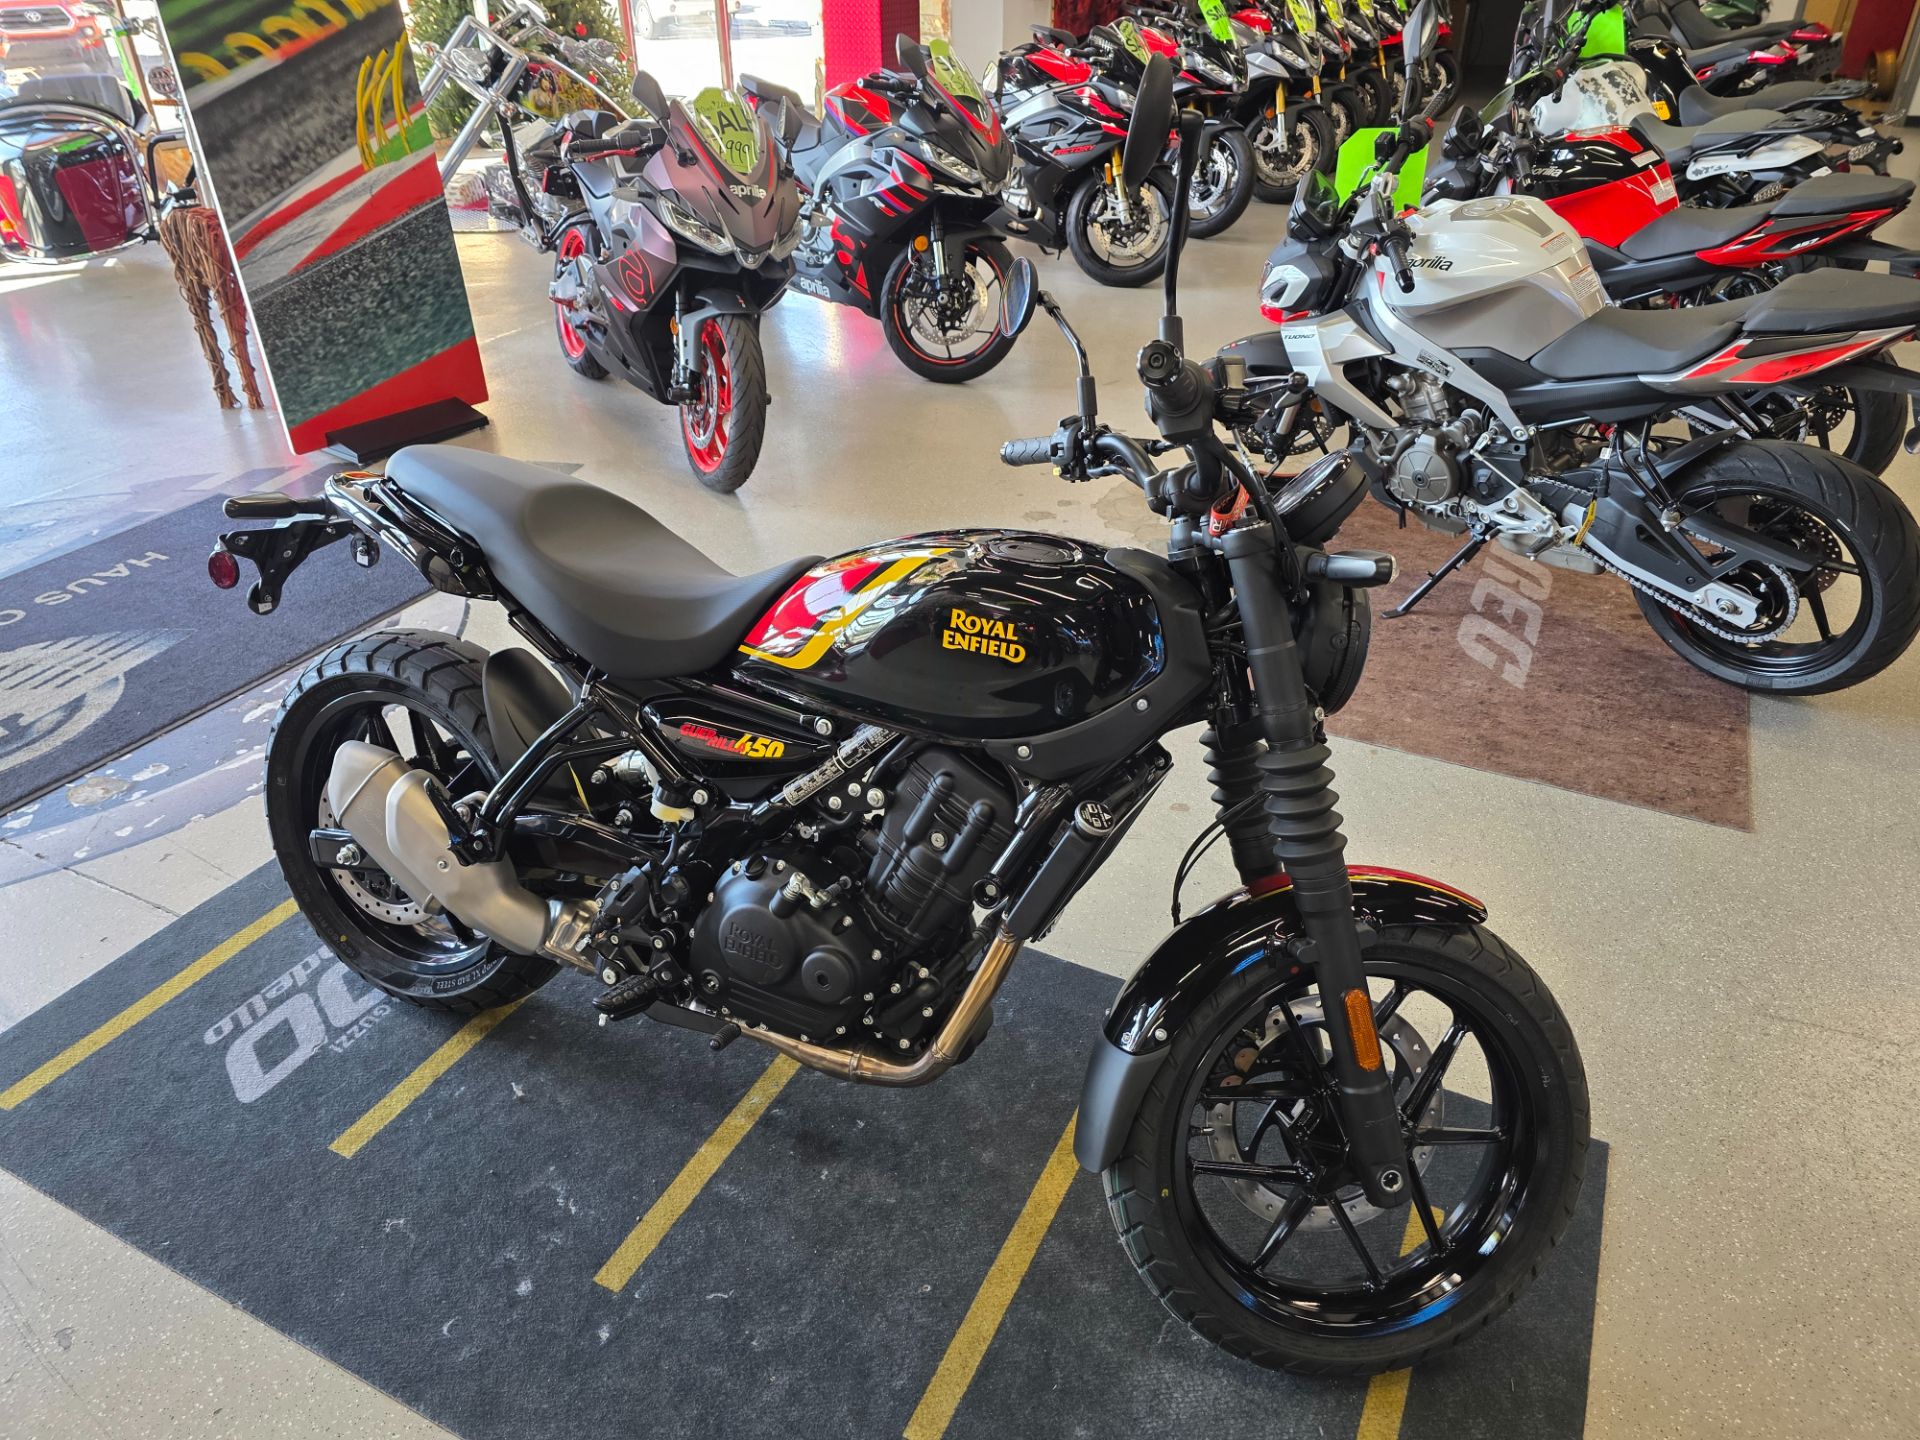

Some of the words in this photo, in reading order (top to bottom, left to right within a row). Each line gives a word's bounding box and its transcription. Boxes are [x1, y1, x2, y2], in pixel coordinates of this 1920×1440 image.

[1053, 144, 1096, 156] FACTORY
[729, 184, 767, 199] aprilia
[800, 277, 831, 298] aprilia
[34, 551, 170, 606] HAUS
[950, 608, 1018, 641] ROYAL
[942, 629, 1026, 664] ENFIELD
[734, 732, 785, 759] 450
[725, 935, 784, 970] ENFIELD
[730, 921, 778, 953] ROYAL
[328, 1003, 392, 1053] GUZZI
